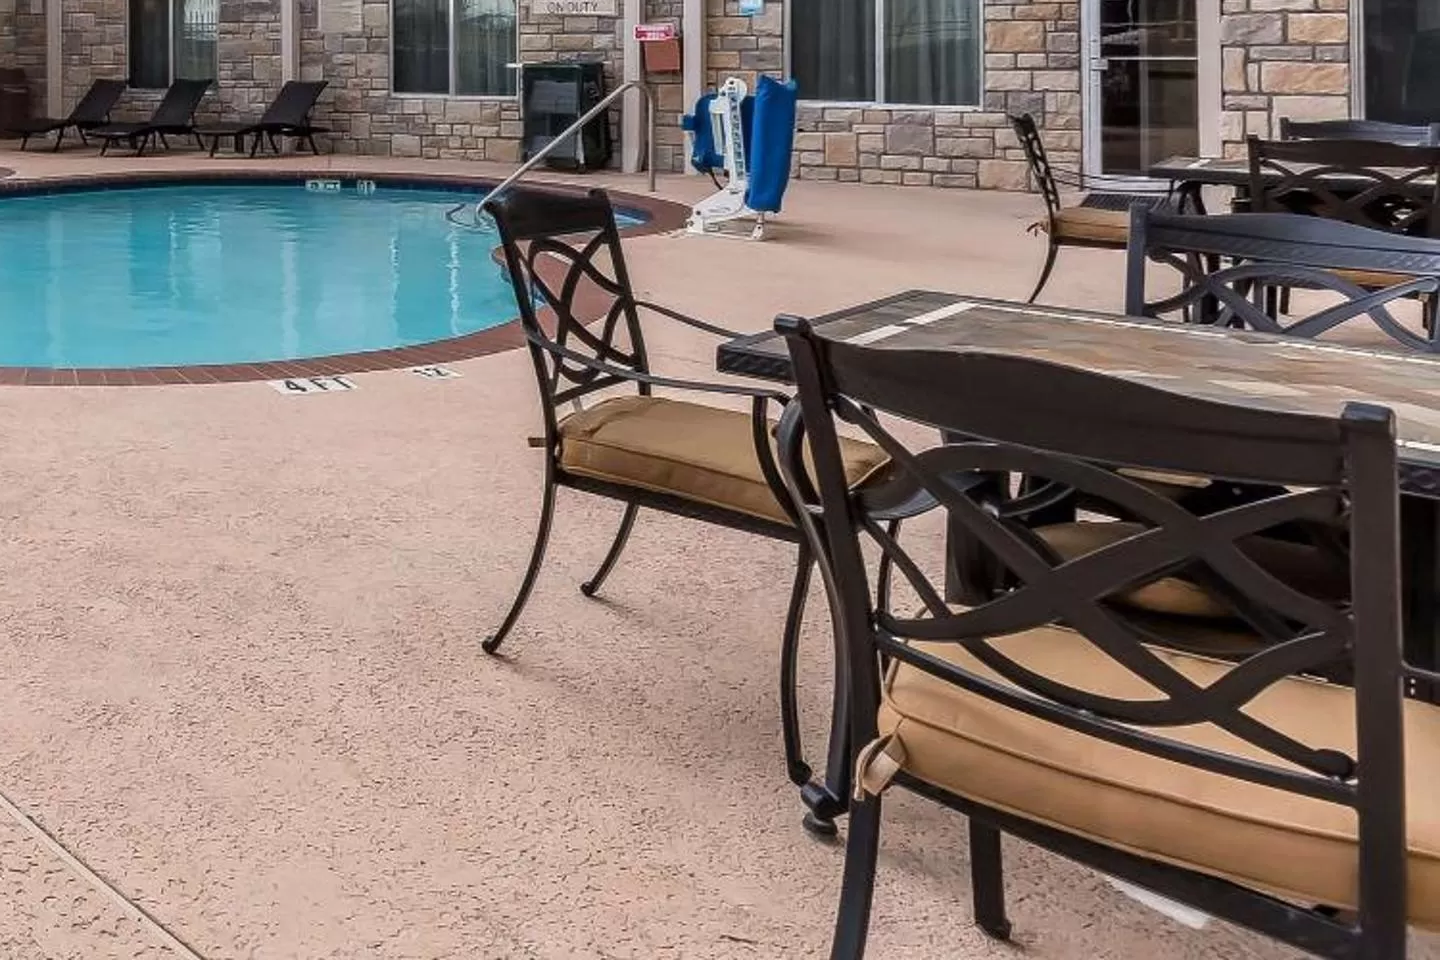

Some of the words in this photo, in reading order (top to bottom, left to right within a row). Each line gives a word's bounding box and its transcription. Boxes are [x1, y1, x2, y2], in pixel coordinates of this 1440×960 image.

[547, 2, 563, 13] ON
[568, 1, 598, 12] DUTY
[284, 379, 307, 392] 4
[309, 376, 352, 391] FT
